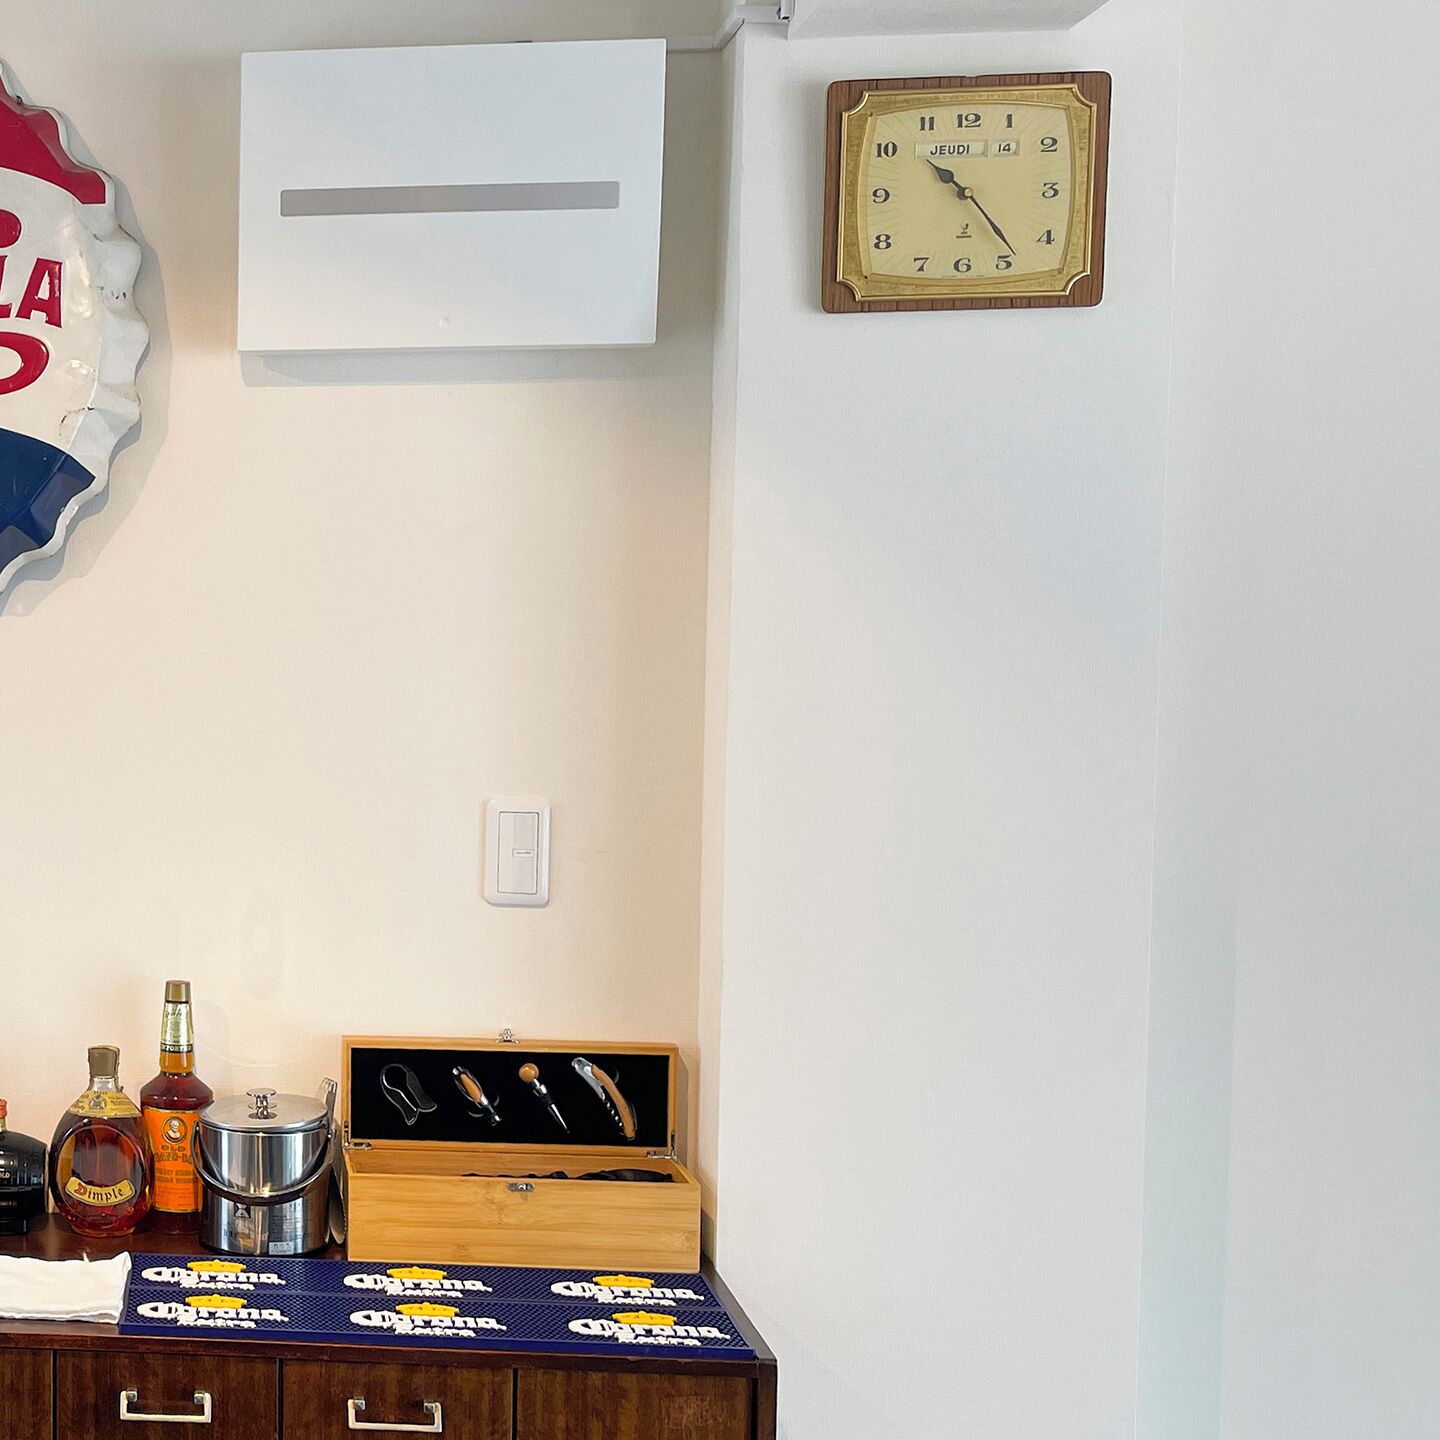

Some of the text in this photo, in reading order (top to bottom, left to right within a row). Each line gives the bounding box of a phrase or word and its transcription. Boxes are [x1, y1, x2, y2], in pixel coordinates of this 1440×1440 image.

[919, 113, 1013, 131] 11 12 1
[876, 141, 898, 158] 10
[930, 143, 1011, 156] JEUDI 14
[1040, 136, 1058, 153] 2
[872, 188, 890, 204] 9
[1041, 182, 1059, 198] 3
[873, 234, 892, 250] 8
[1036, 229, 1055, 245] 4
[913, 254, 1013, 273] 7 6 5
[73, 1182, 124, 1203] Dimple
[141, 1266, 286, 1285] Corona
[343, 1273, 493, 1293] Corona
[550, 1281, 705, 1300] Corona
[137, 1301, 290, 1322] Corona
[350, 1310, 508, 1331] Corona
[568, 1318, 731, 1340] Corona
